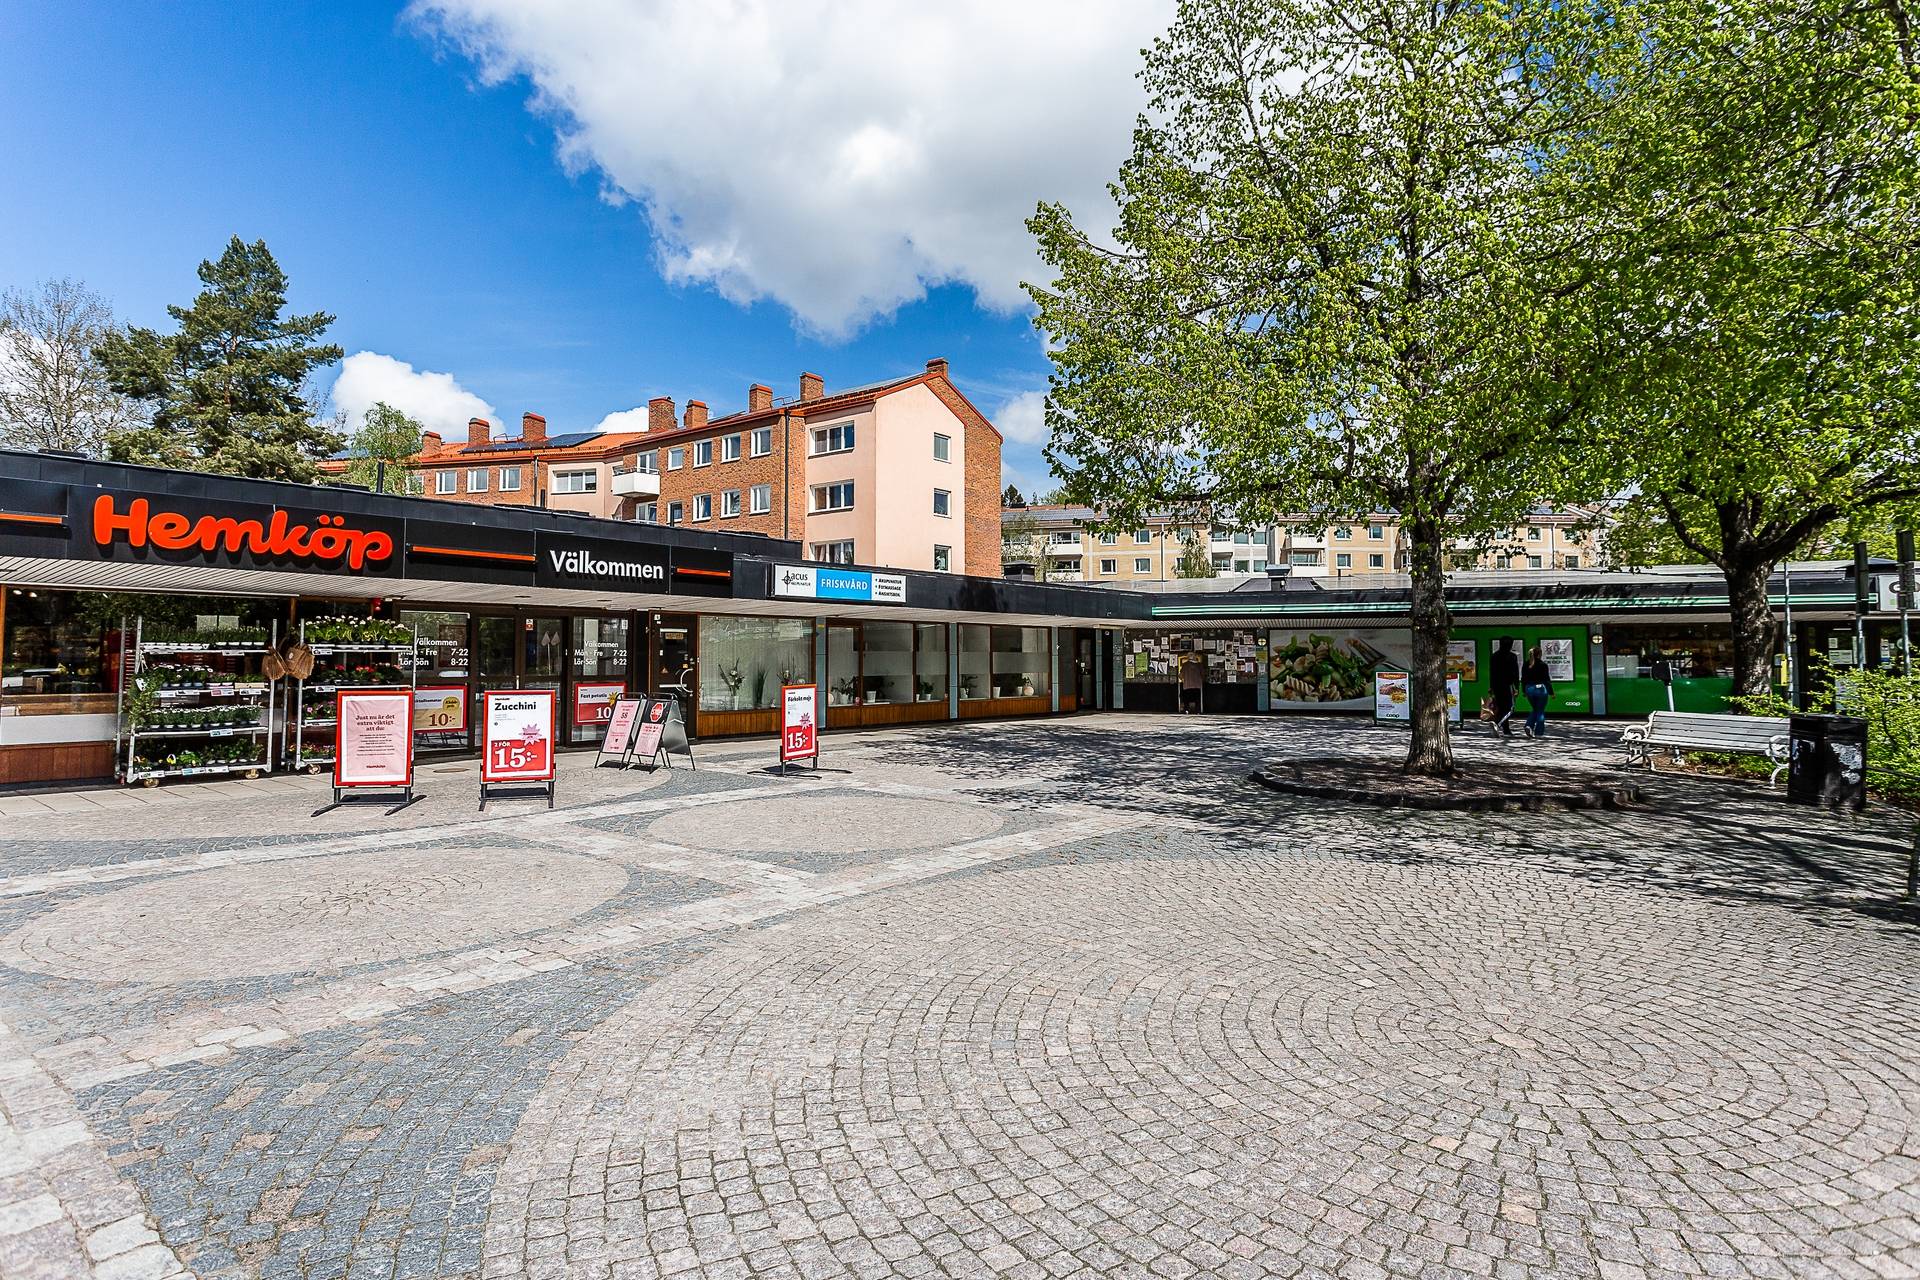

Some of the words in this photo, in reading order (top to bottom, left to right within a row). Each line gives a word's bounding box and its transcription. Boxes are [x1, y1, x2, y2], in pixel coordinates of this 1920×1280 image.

[94, 494, 393, 570] Hemköp
[550, 550, 664, 579] Välkommen
[821, 577, 868, 591] FRISKVÅRD
[584, 640, 619, 648] Välkommen
[425, 647, 438, 656] Fre
[451, 648, 469, 656] 7-22
[613, 649, 627, 657] 7-22
[400, 657, 429, 666] LörSön
[450, 658, 469, 666] 8-22
[613, 658, 627, 666] 8-22
[494, 701, 537, 711] Zucchini
[596, 706, 612, 719] 10
[428, 713, 456, 727] 10:-
[788, 731, 809, 749] 15:-
[494, 747, 538, 769] 15:-
